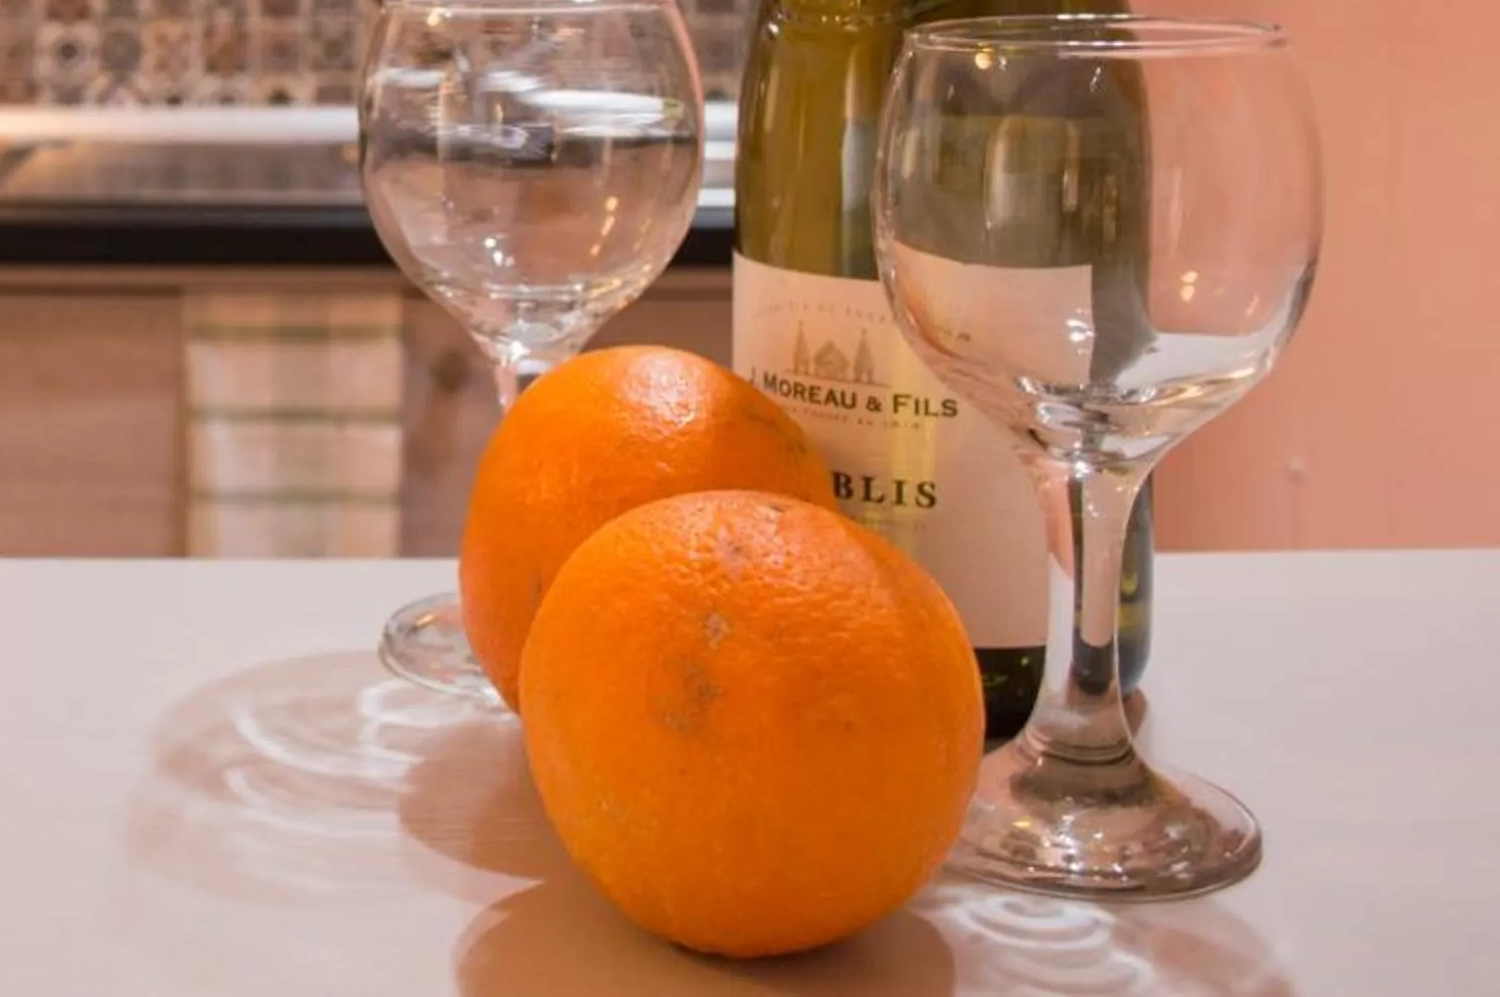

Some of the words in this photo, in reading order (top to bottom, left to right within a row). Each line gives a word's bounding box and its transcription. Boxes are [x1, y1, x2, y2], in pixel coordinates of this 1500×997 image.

[763, 370, 858, 410] MOREAU
[865, 395, 883, 413] &
[892, 393, 959, 418] FILS
[831, 470, 938, 509] BLIS
